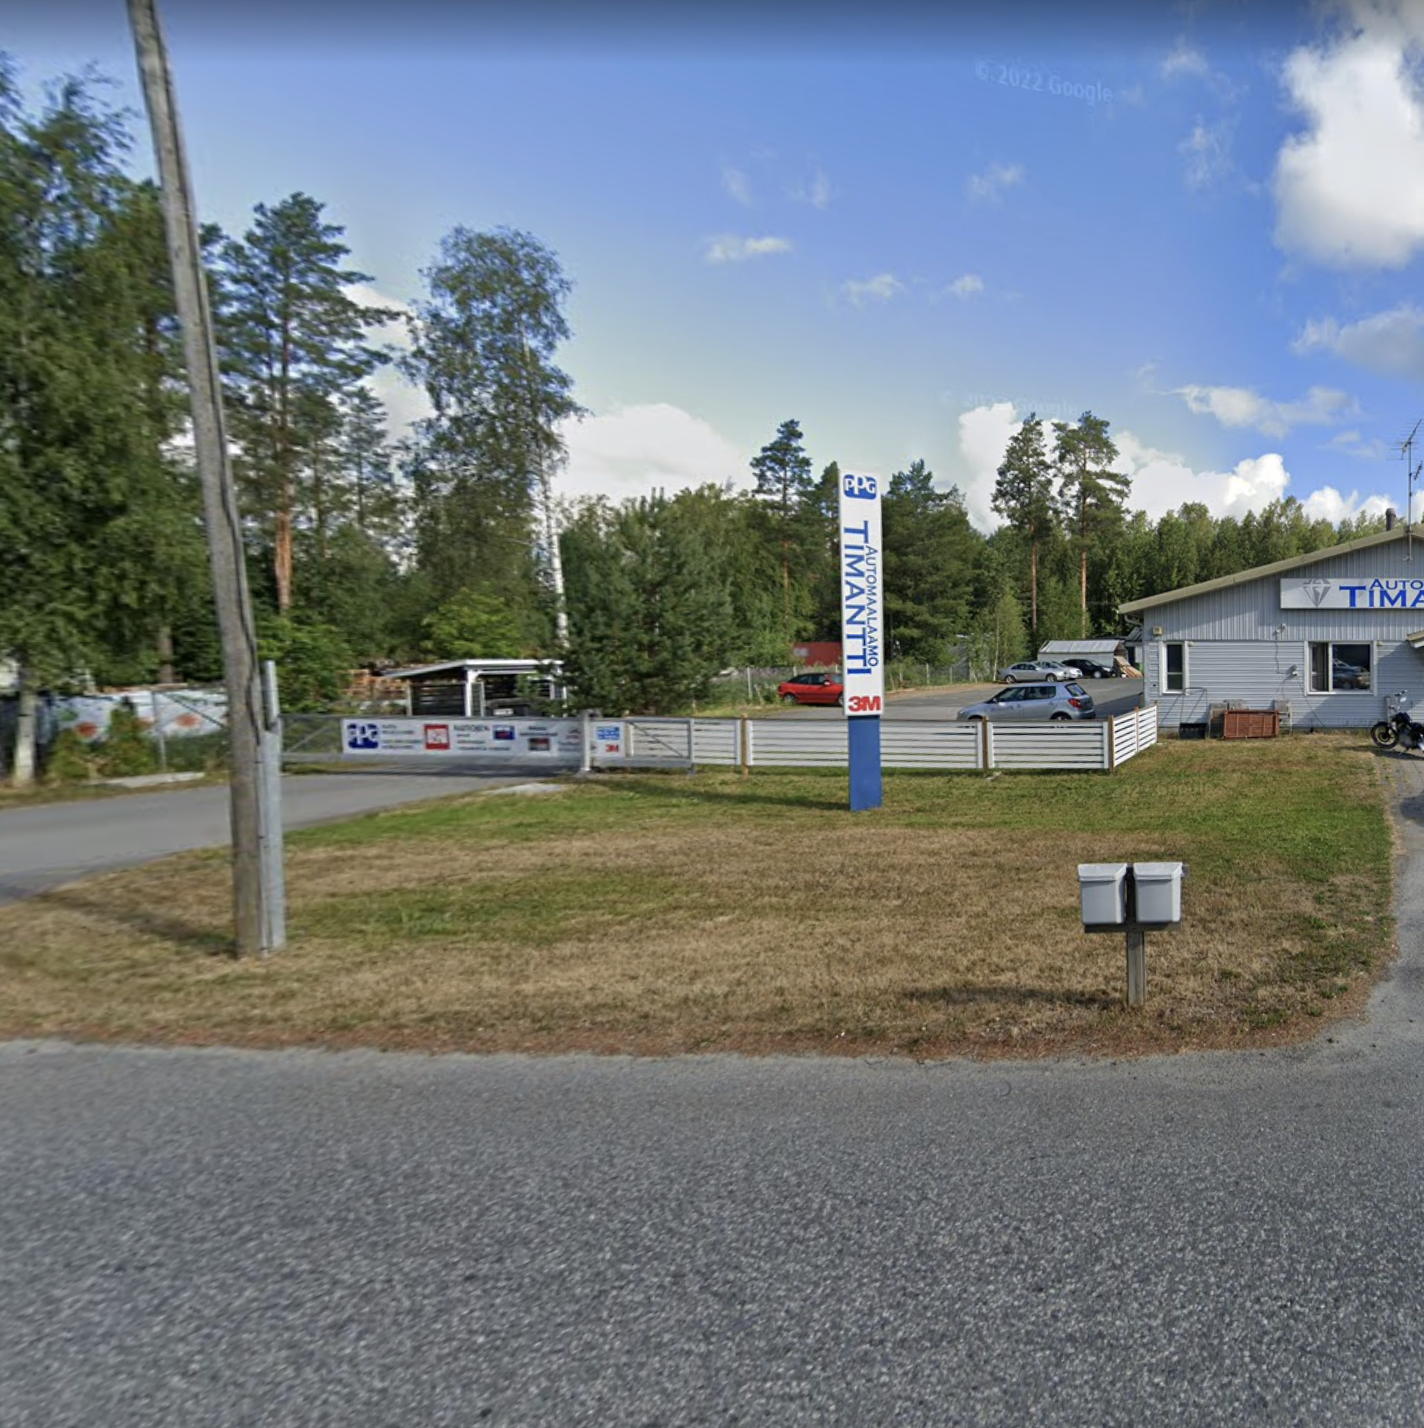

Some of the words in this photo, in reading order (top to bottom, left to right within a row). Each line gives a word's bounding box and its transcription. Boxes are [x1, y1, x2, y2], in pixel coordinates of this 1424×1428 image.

[844, 474, 877, 498] PPG
[843, 520, 872, 675] TIMANTTI
[865, 544, 879, 667] AUTOMAALAAMO
[848, 695, 882, 712] 3M
